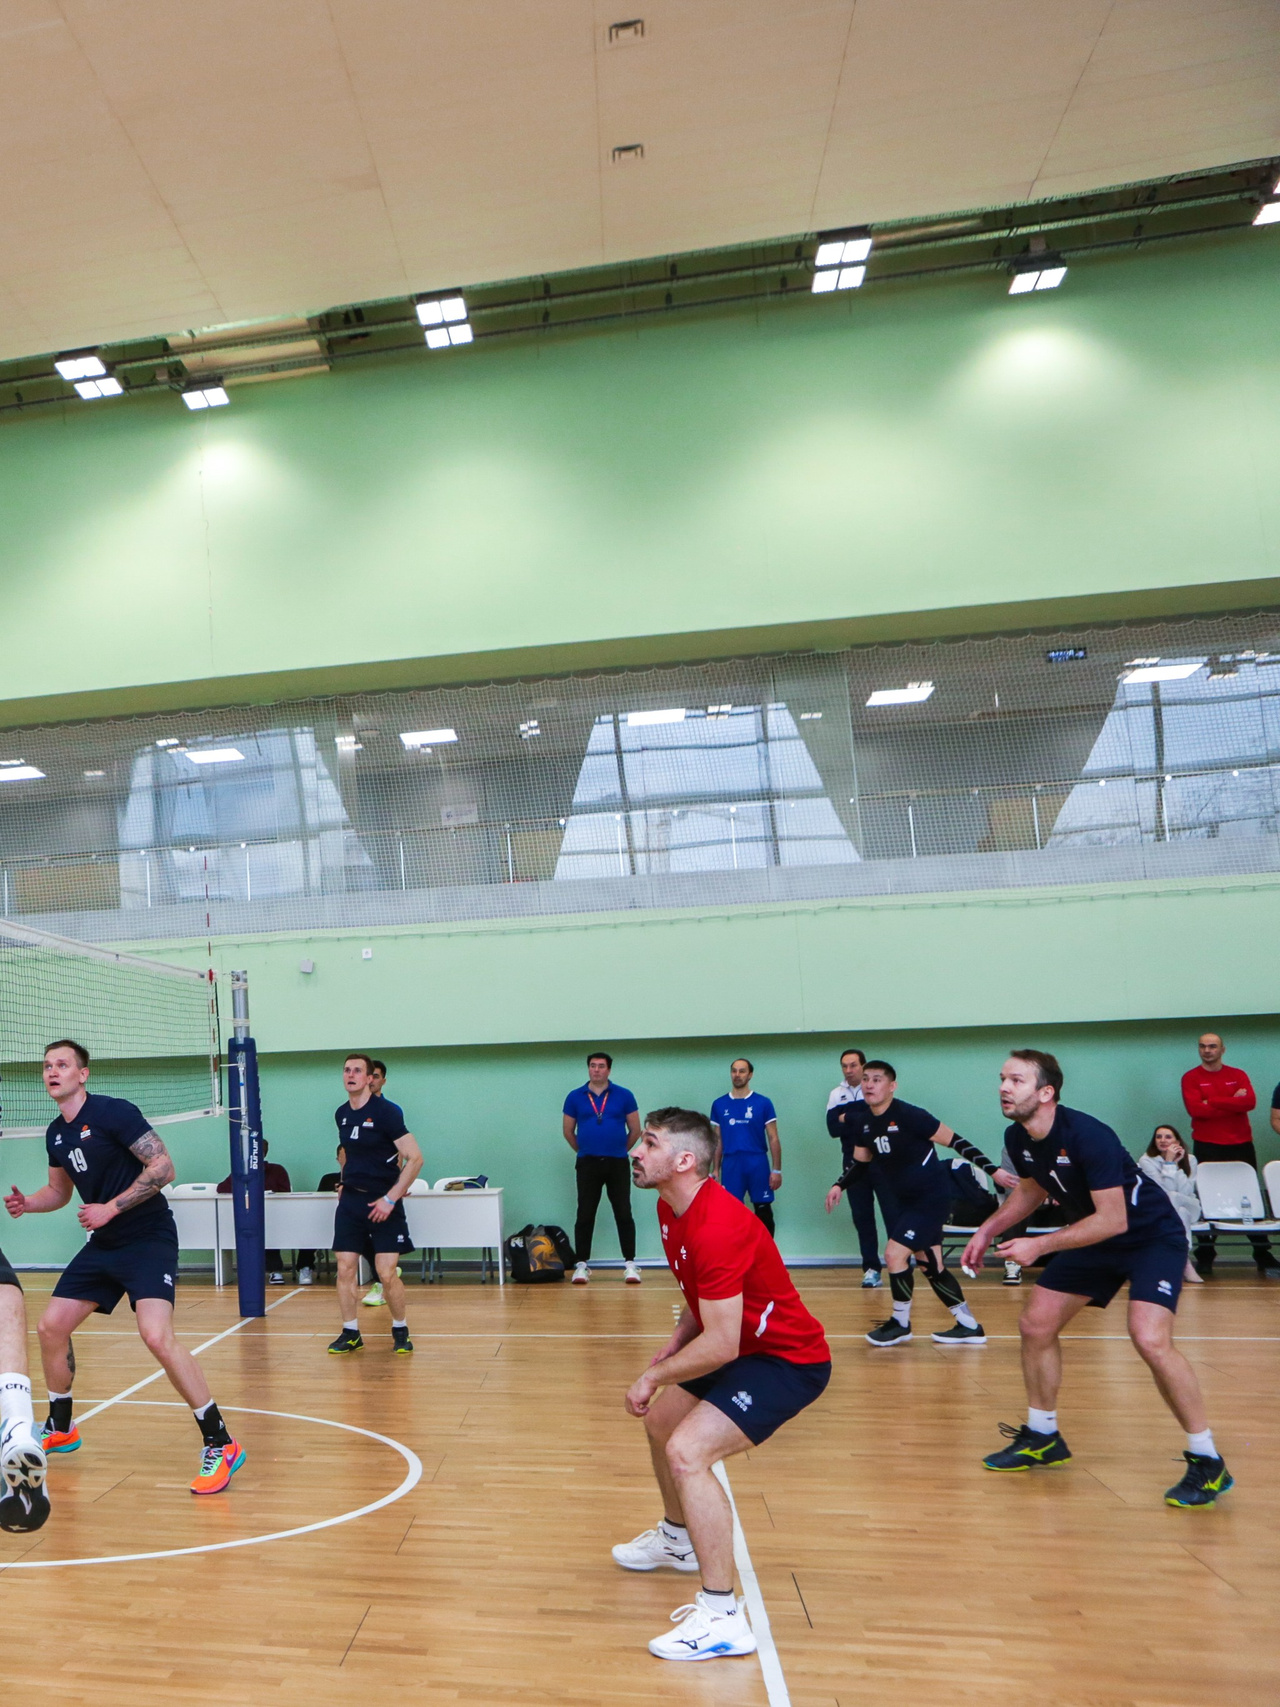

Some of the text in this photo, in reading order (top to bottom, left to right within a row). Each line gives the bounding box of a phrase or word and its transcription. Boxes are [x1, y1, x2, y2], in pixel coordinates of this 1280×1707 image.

[350, 1125, 360, 1140] 4
[873, 1135, 891, 1154] 16
[68, 1147, 88, 1173] 19
